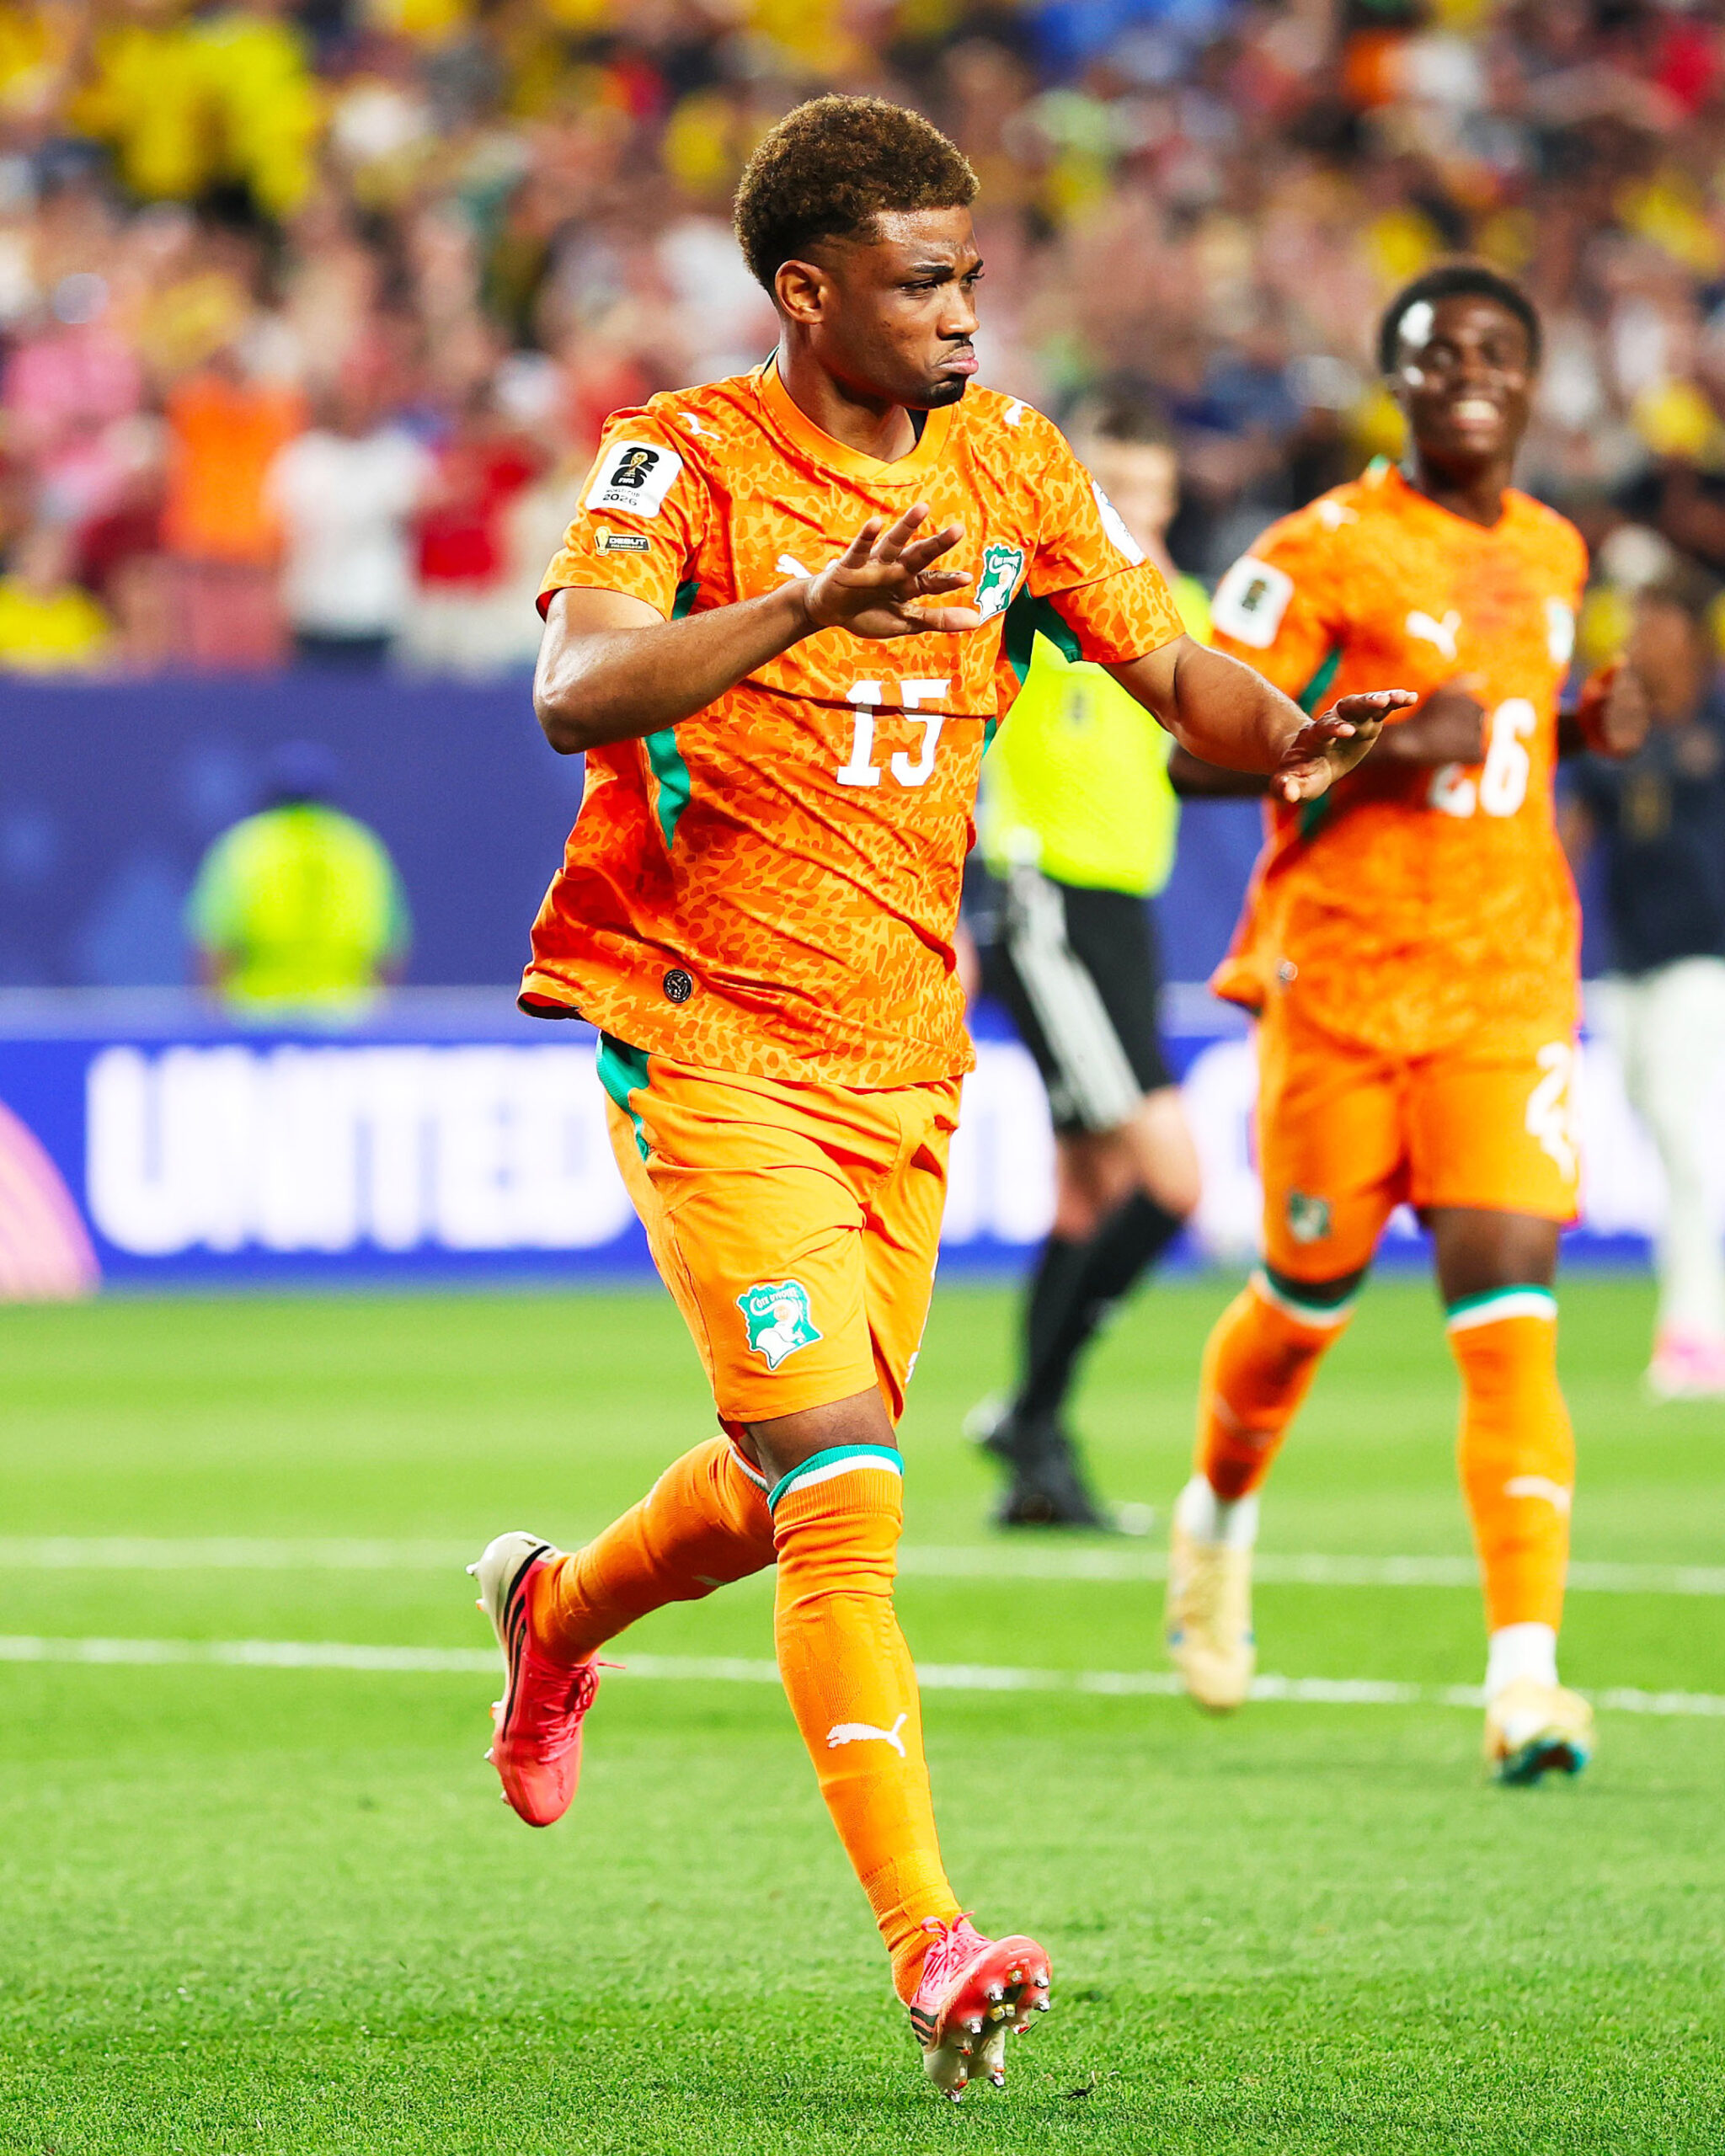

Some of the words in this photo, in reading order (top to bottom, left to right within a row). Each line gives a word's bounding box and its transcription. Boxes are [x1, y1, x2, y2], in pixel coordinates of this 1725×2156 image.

[602, 494, 638, 506] 2026
[609, 537, 647, 546] DEBUT
[836, 679, 952, 787] 15
[88, 1047, 633, 1251] UNITED
